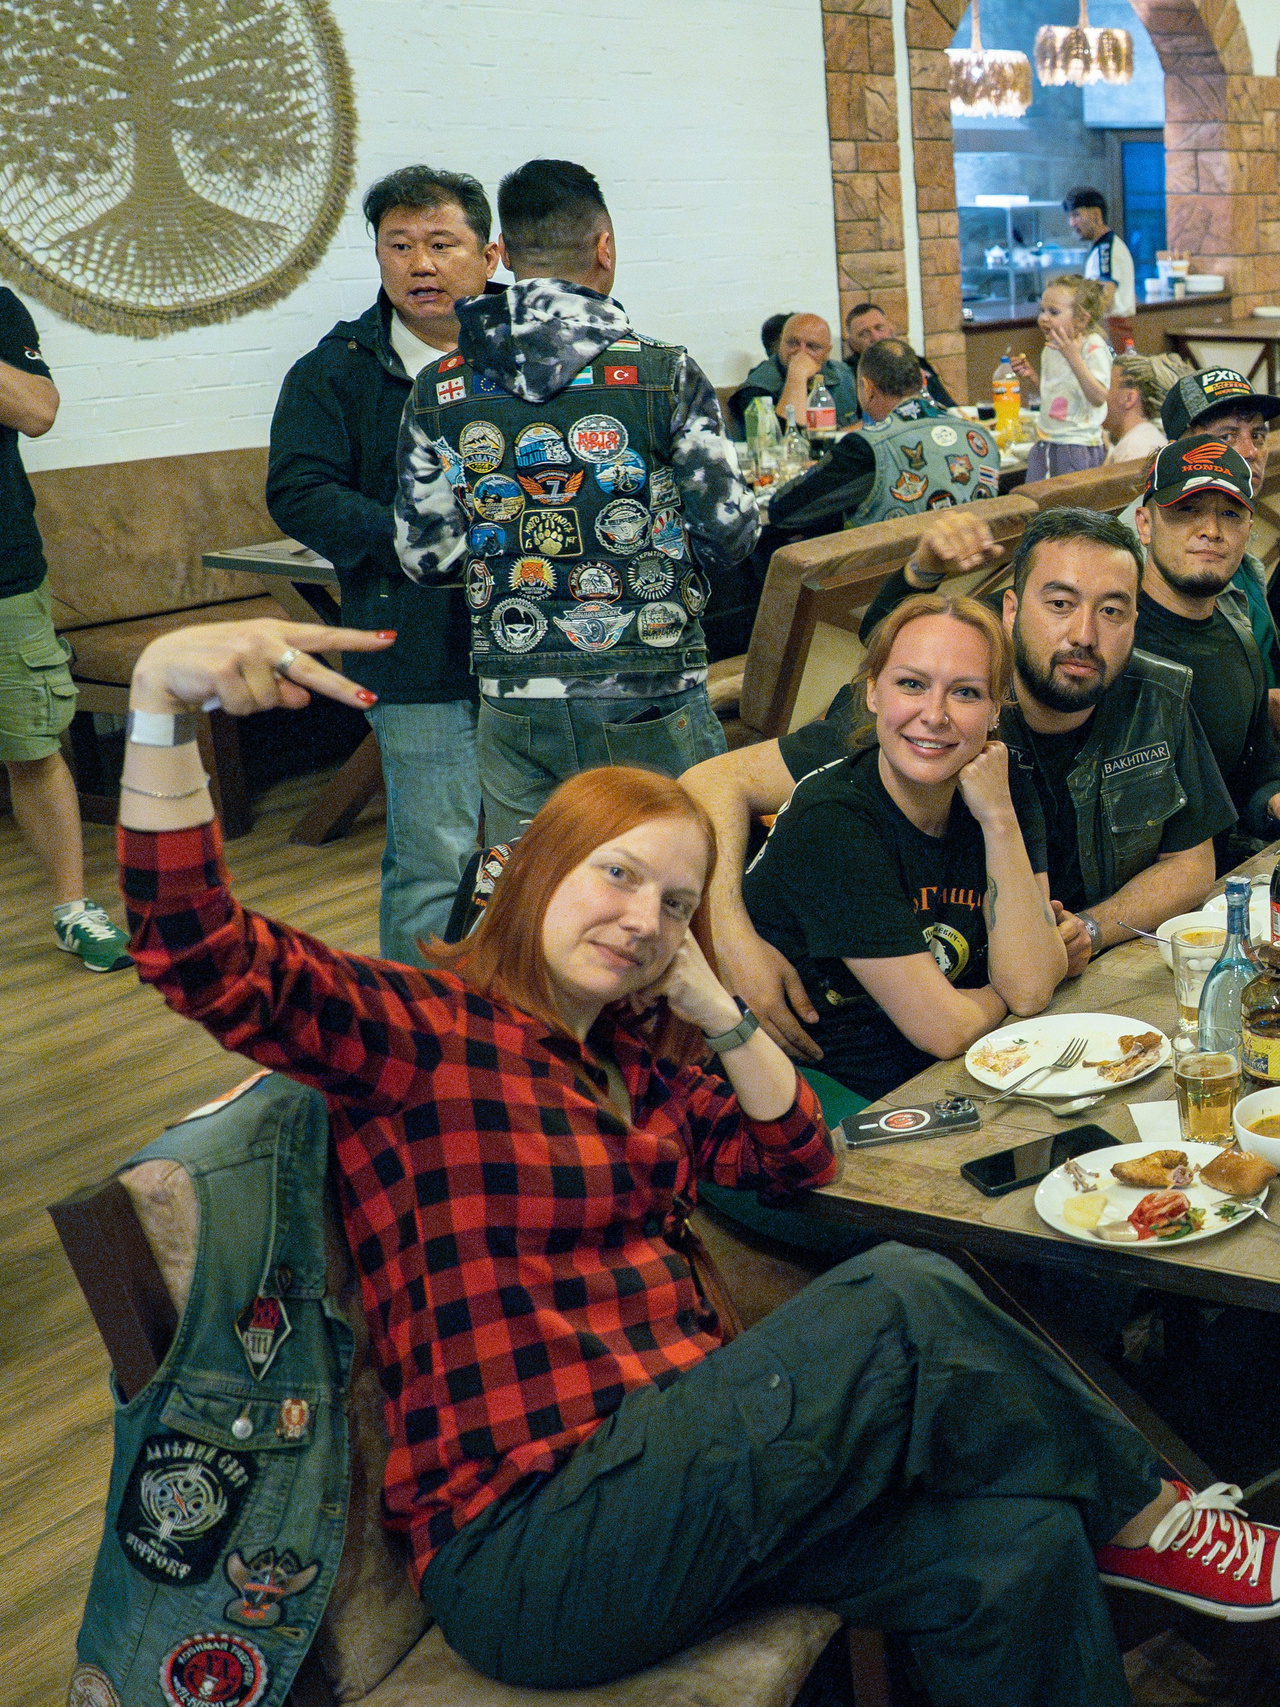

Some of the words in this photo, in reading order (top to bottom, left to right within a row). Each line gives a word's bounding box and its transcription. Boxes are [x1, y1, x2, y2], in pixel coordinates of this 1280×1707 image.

[1202, 370, 1241, 387] FXR
[577, 431, 618, 441] МОТО
[576, 440, 619, 452] ТУРИСТ
[1181, 464, 1234, 477] HONDA
[632, 550, 666, 565] ОТКРЫТИЕ
[1104, 746, 1167, 774] BAKHTIYAR
[126, 1532, 192, 1580] SUPPORT
